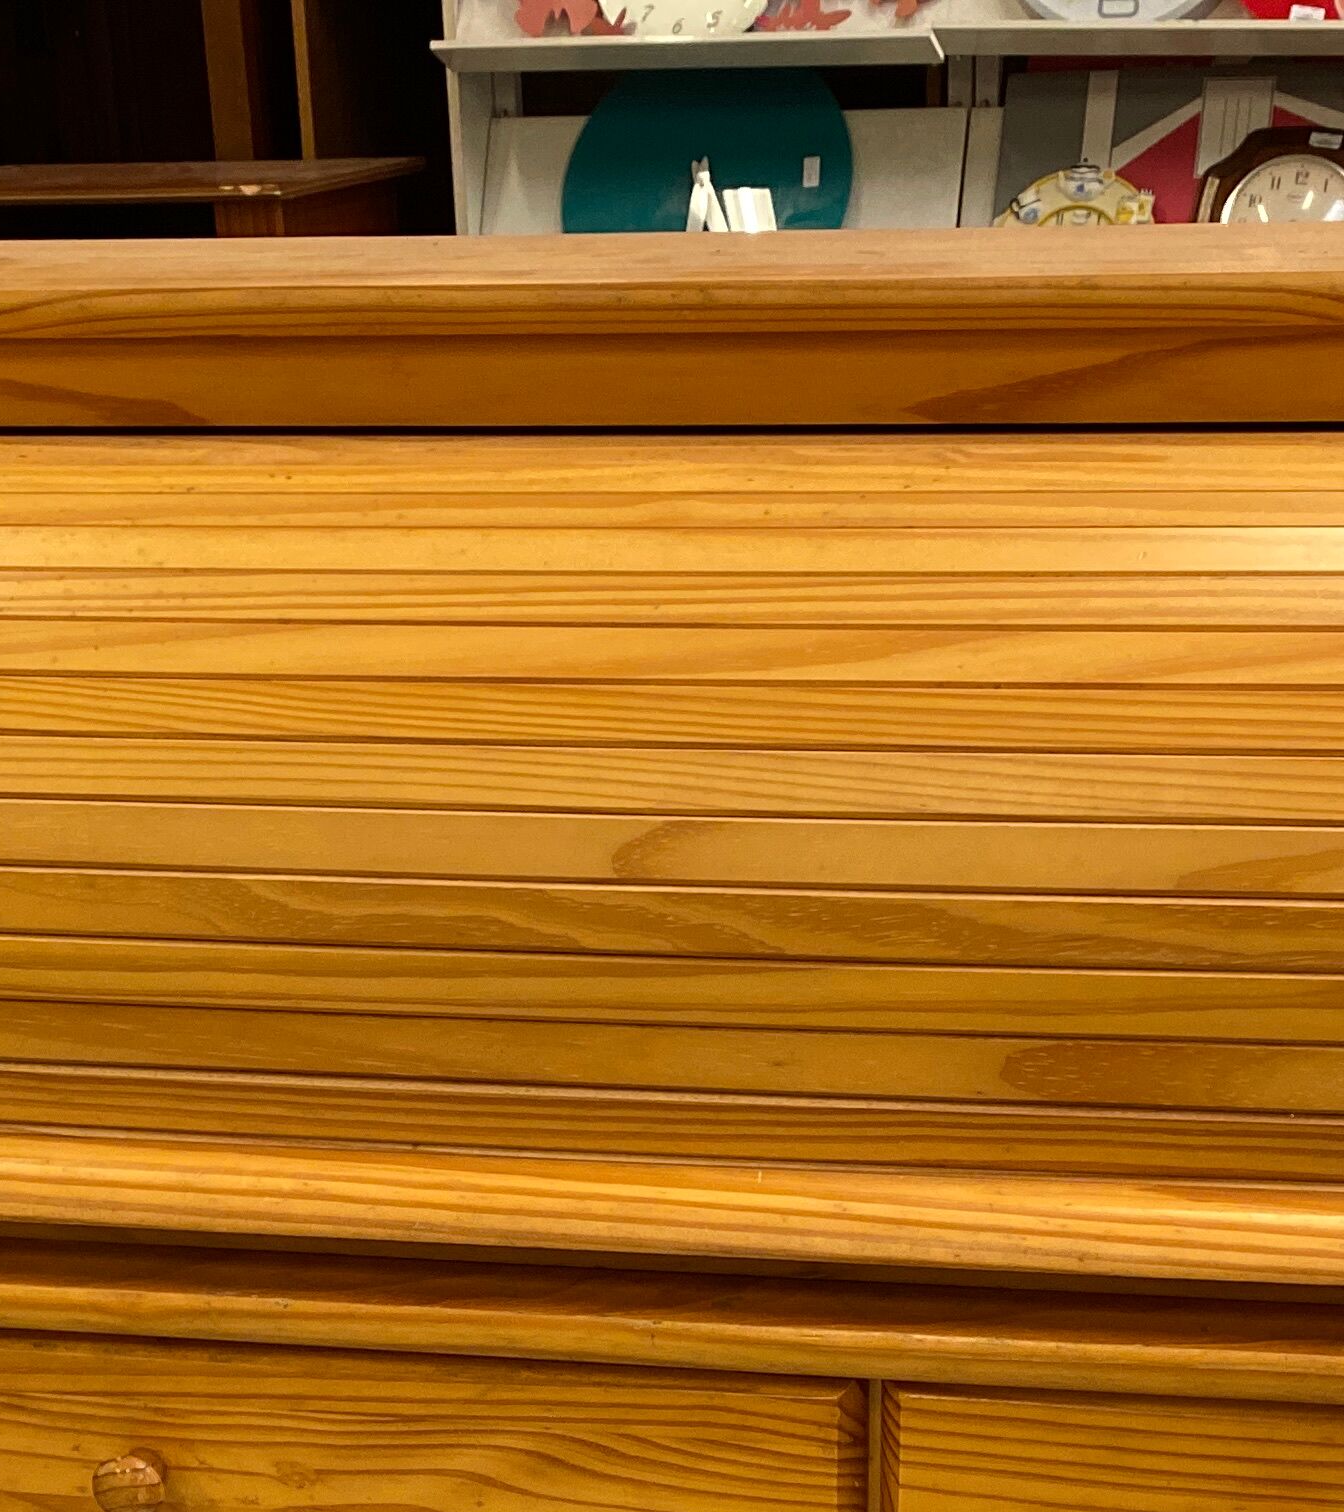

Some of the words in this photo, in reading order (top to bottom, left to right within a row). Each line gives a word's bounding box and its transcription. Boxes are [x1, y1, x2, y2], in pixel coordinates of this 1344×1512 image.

[641, 4, 655, 23] 7
[706, 10, 723, 29] 5
[671, 17, 685, 35] 6
[1270, 175, 1282, 191] 11
[1323, 177, 1329, 193] 1
[1248, 193, 1263, 208] 10
